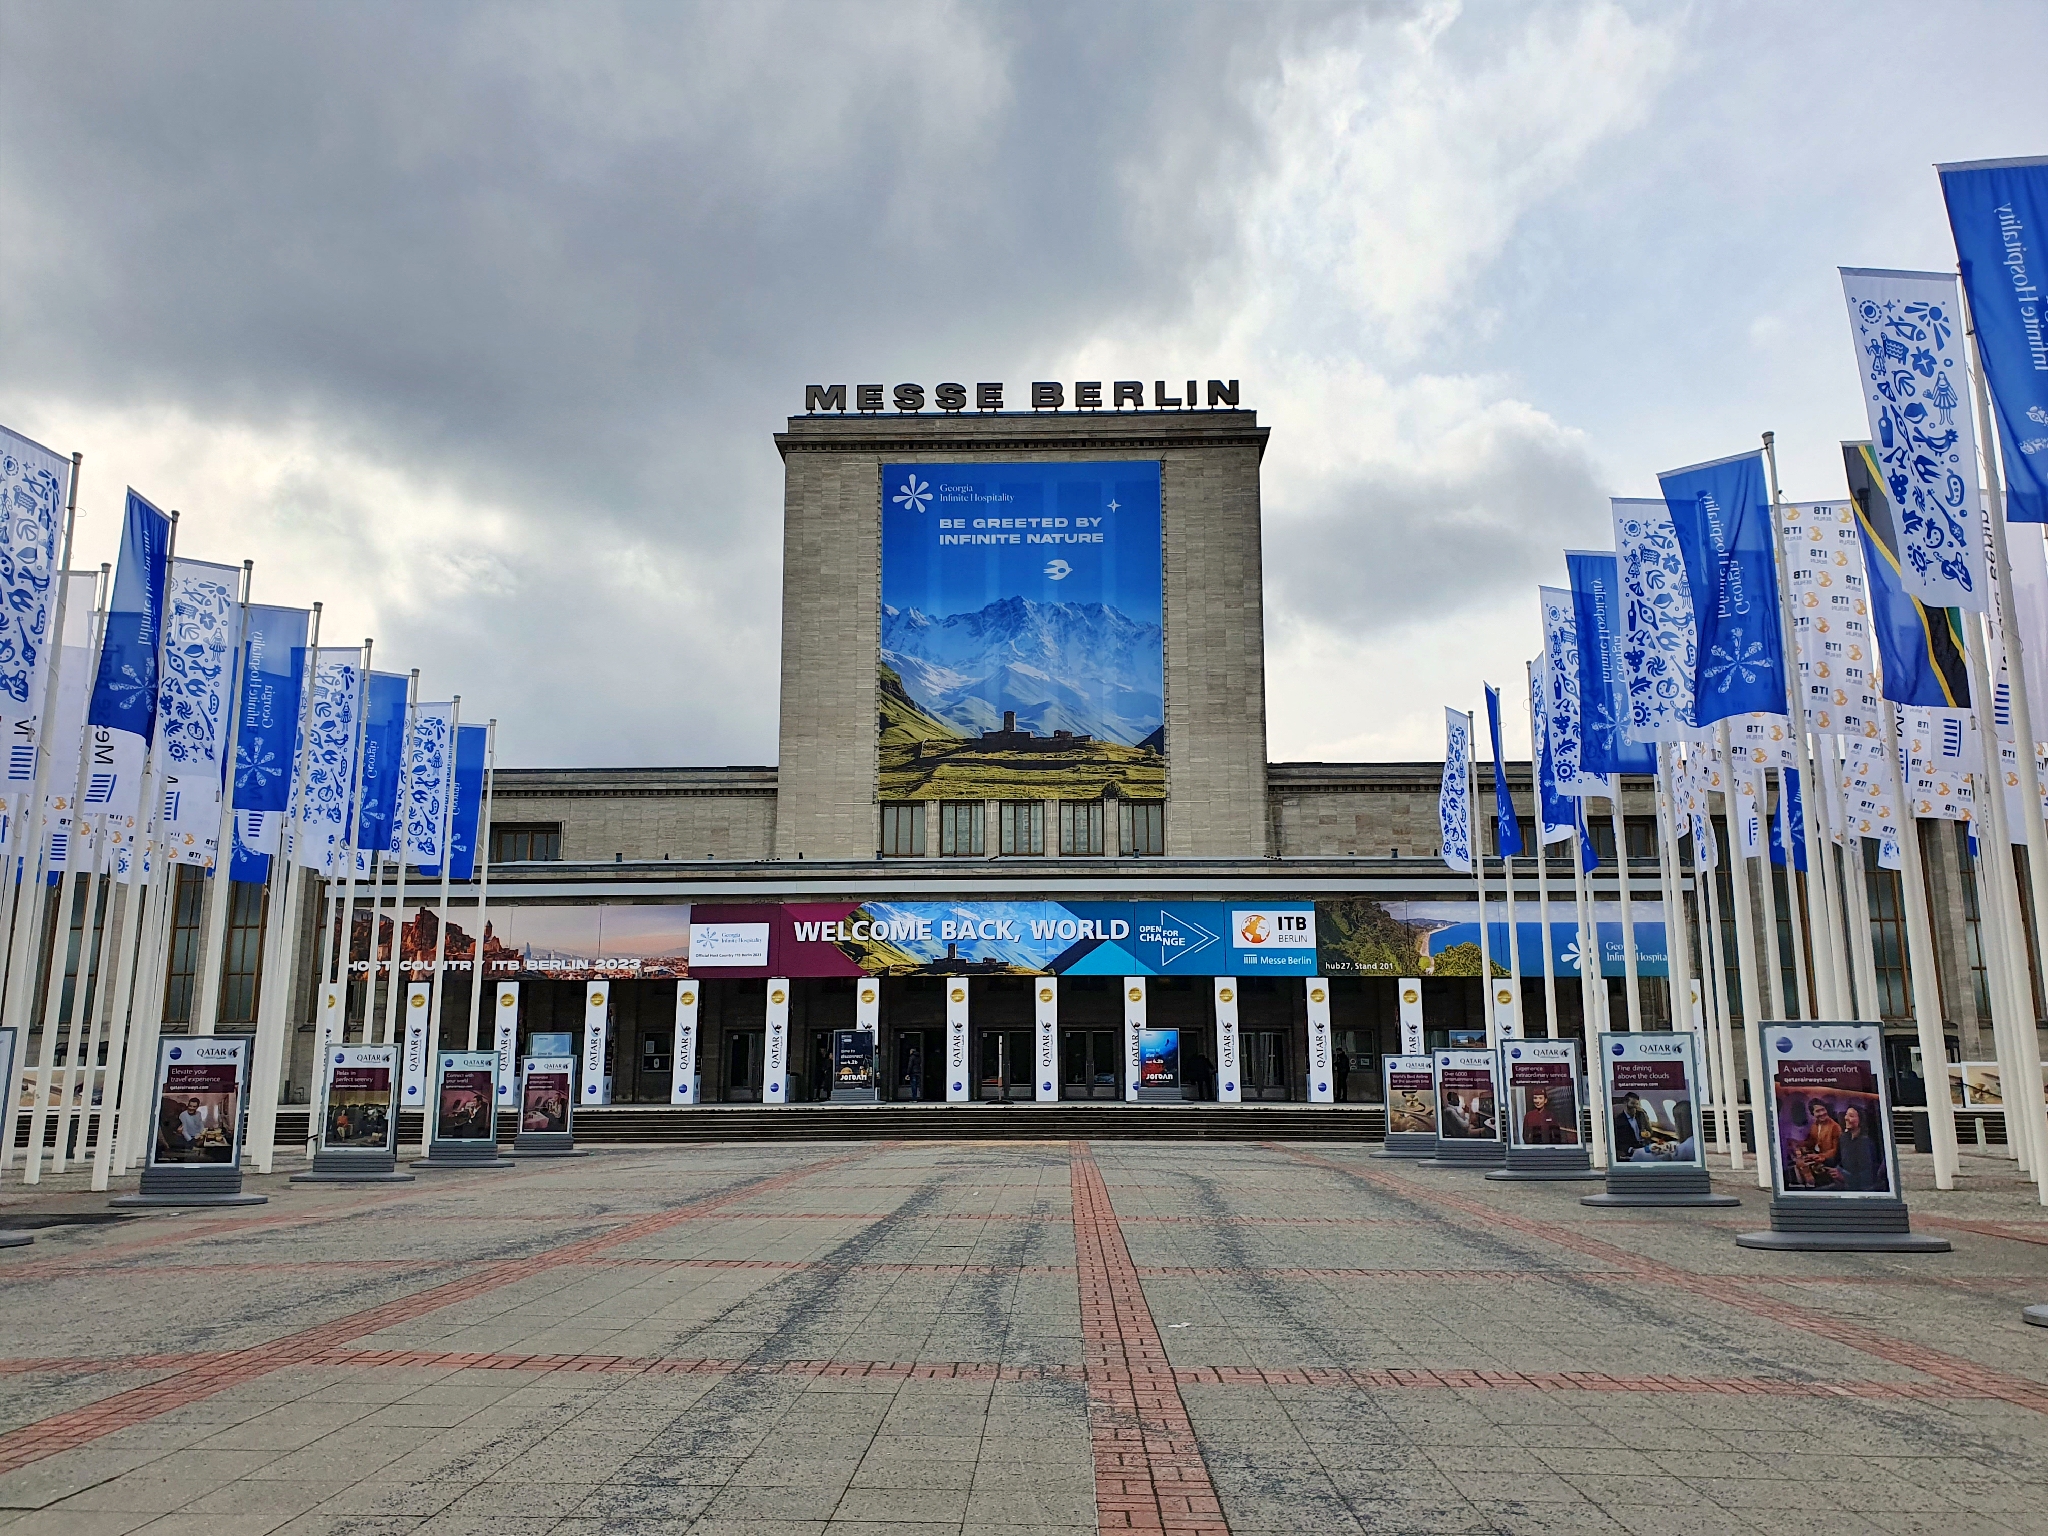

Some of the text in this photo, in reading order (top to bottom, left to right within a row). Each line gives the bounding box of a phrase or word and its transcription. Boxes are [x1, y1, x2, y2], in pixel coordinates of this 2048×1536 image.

[805, 380, 1240, 410] MESSE BERLIN
[939, 483, 973, 494] Georgia
[939, 492, 1014, 503] Infinite Hospitality
[939, 517, 1102, 529] BE GREETED BY
[939, 532, 1104, 546] INFINITE NATURE
[1278, 916, 1307, 930] ITB
[794, 919, 1130, 942] WELCOME BACK, WORLD
[1278, 935, 1308, 943] BERLIN
[1606, 942, 1638, 950] Geoa
[1260, 956, 1312, 965] Messe Berlin
[1636, 952, 1668, 963] Hospita
[400, 960, 485, 971] COUTR
[492, 959, 520, 971] ITB
[526, 959, 589, 971] BERLIN
[594, 958, 642, 972] 2023
[1325, 962, 1394, 972] hub27, Stand 201
[1042, 1034, 1050, 1067] QATAR
[1640, 1044, 1671, 1053] QATAR
[1812, 1038, 1853, 1050] QATAR
[196, 1048, 226, 1058] QATAR
[409, 1040, 419, 1072] QATAR
[500, 1038, 510, 1071] QATAR
[589, 1037, 598, 1071] QATAR
[680, 1038, 689, 1070] QATAR
[771, 1036, 780, 1068] QATAR
[953, 1034, 962, 1068] QATAR
[1224, 1035, 1233, 1068] QATAR
[1316, 1034, 1325, 1068] QATAR
[356, 1054, 380, 1062] QATAR
[1632, 1064, 1652, 1072] dining
[1792, 1064, 1814, 1072] world
[1816, 1064, 1824, 1072] of
